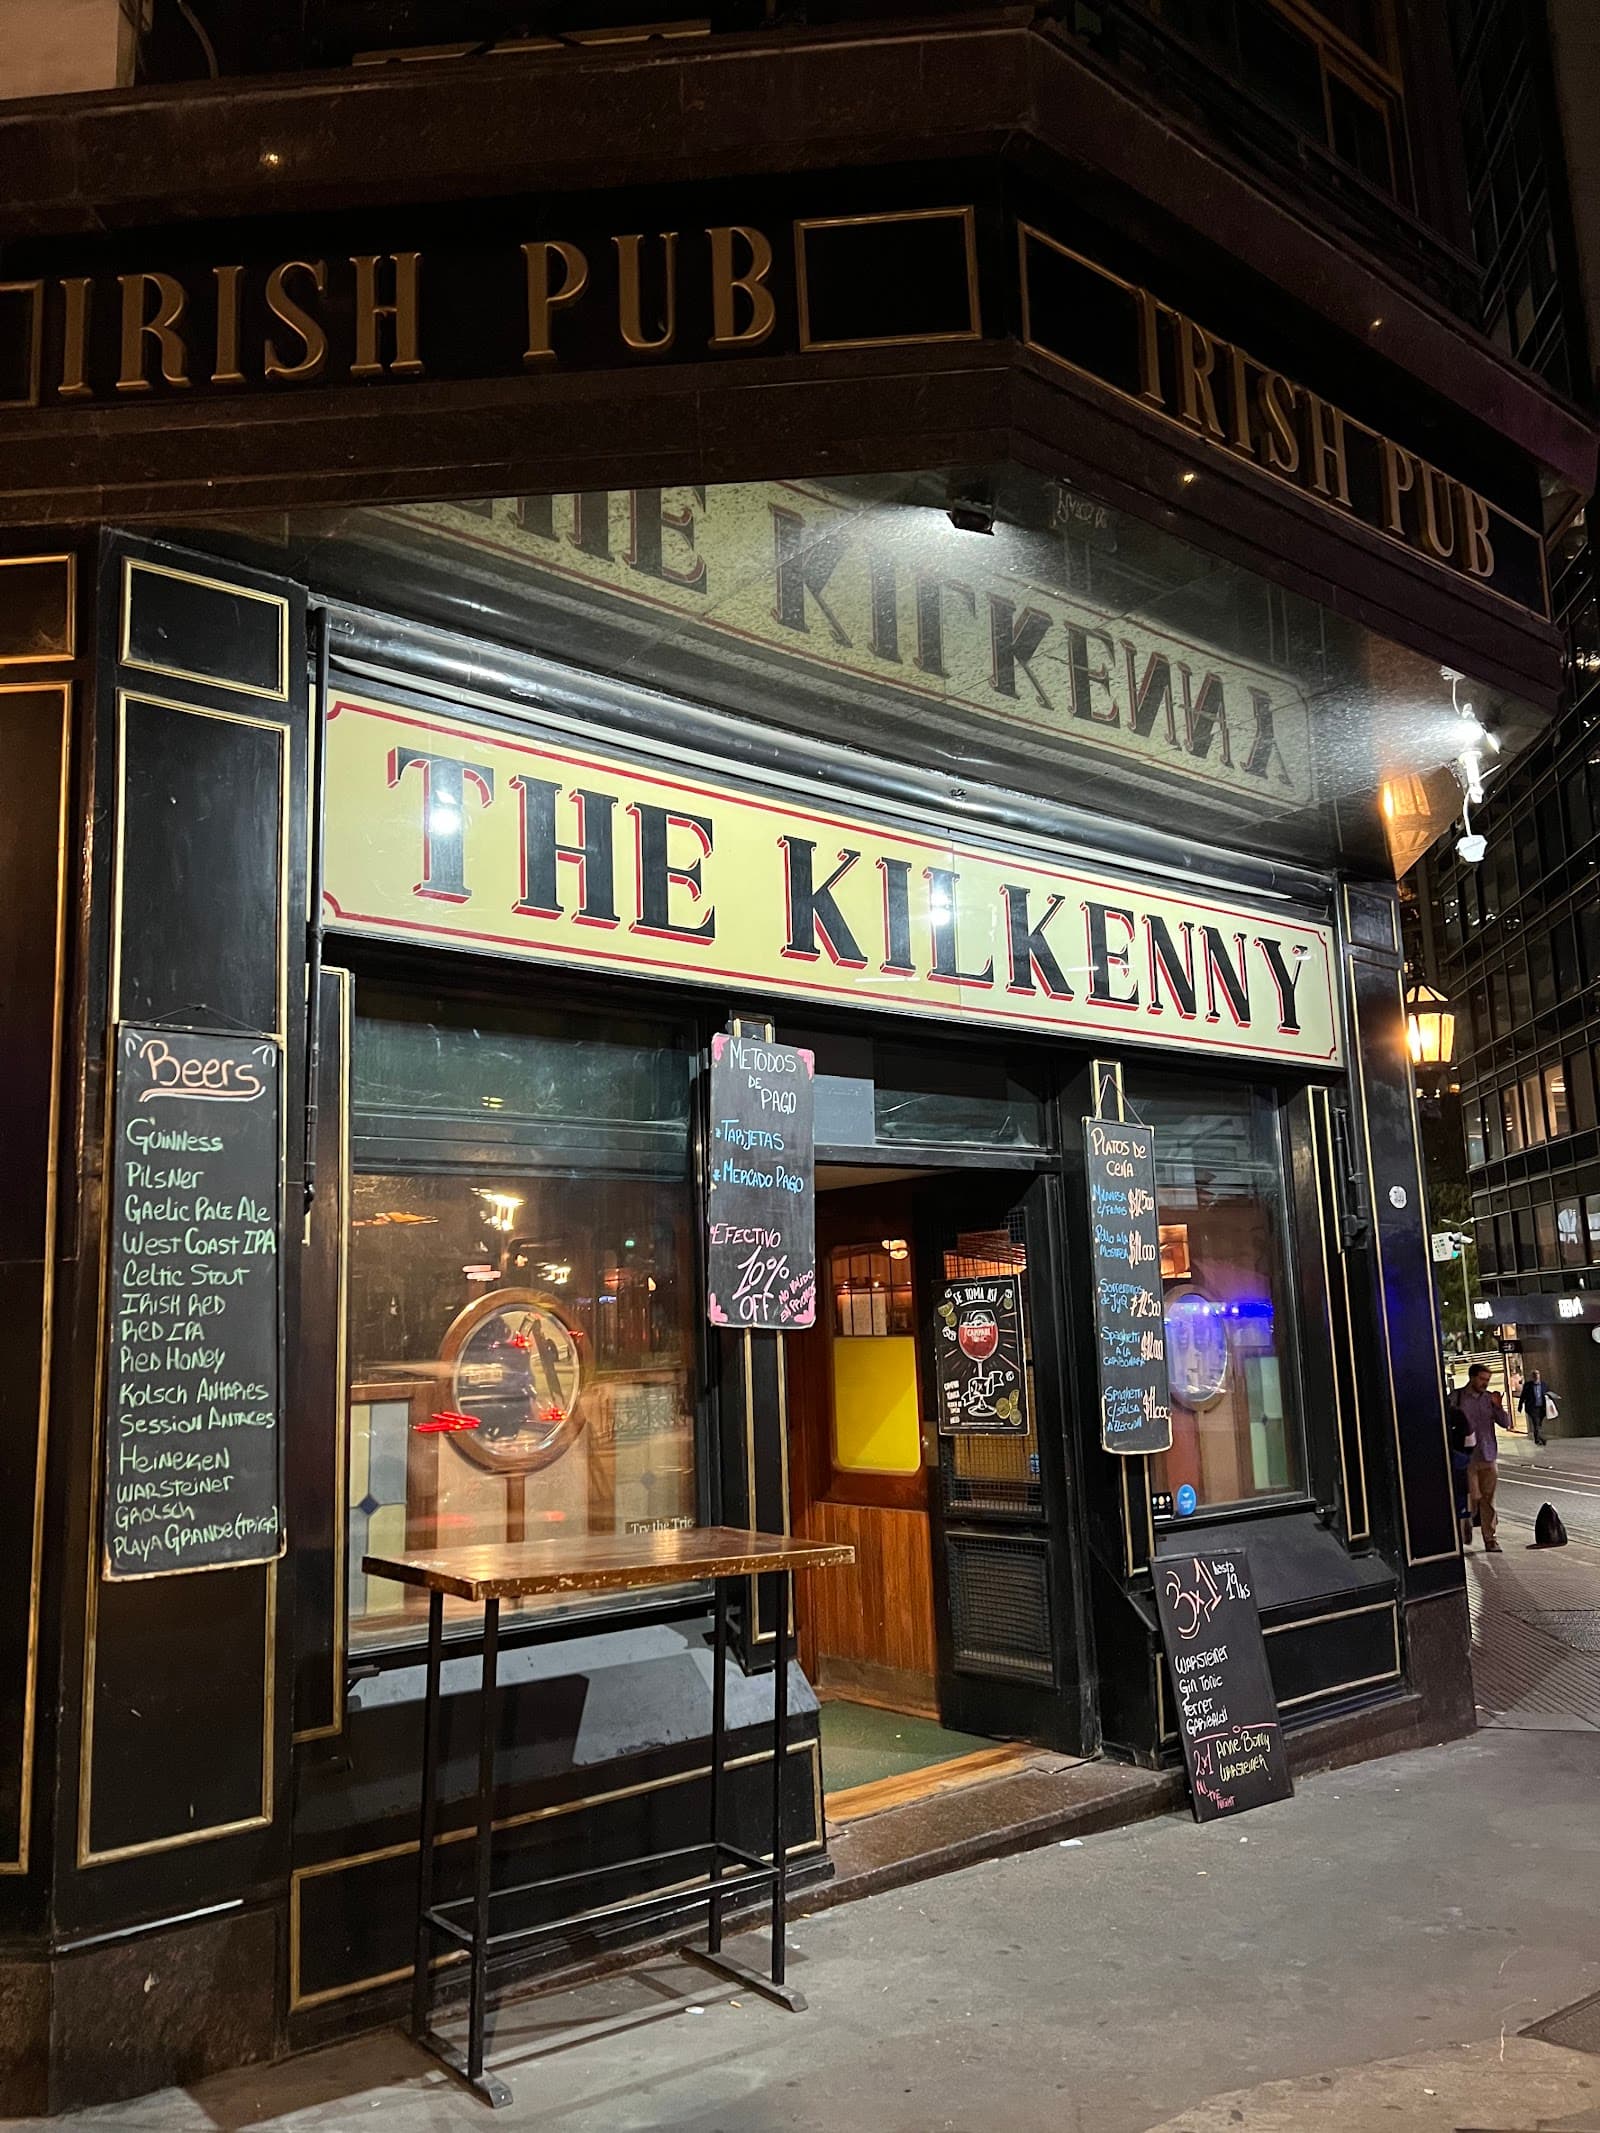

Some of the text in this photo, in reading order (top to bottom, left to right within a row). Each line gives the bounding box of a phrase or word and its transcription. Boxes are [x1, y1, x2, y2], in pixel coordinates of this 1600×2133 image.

[58, 226, 776, 397] IRISH PUB
[1135, 289, 1496, 579] IRISH PUB
[387, 746, 1309, 1036] THE KILKENNY
[139, 1040, 261, 1092] Beers
[729, 1039, 798, 1073] METODOS
[748, 1075, 762, 1090] DE
[760, 1088, 798, 1115] PAGO
[720, 1119, 785, 1151] TARJETAS
[722, 1158, 804, 1194] MERCADO PAGO
[242, 1229, 276, 1255] IPA
[731, 1245, 790, 1300] 10%
[739, 1292, 775, 1322] OFF
[952, 1290, 962, 1306] SE
[964, 1286, 985, 1301] TOMA
[1558, 1295, 1585, 1318] BBVA
[166, 1322, 205, 1342] IPA
[1166, 1558, 1223, 1640] 3x1
